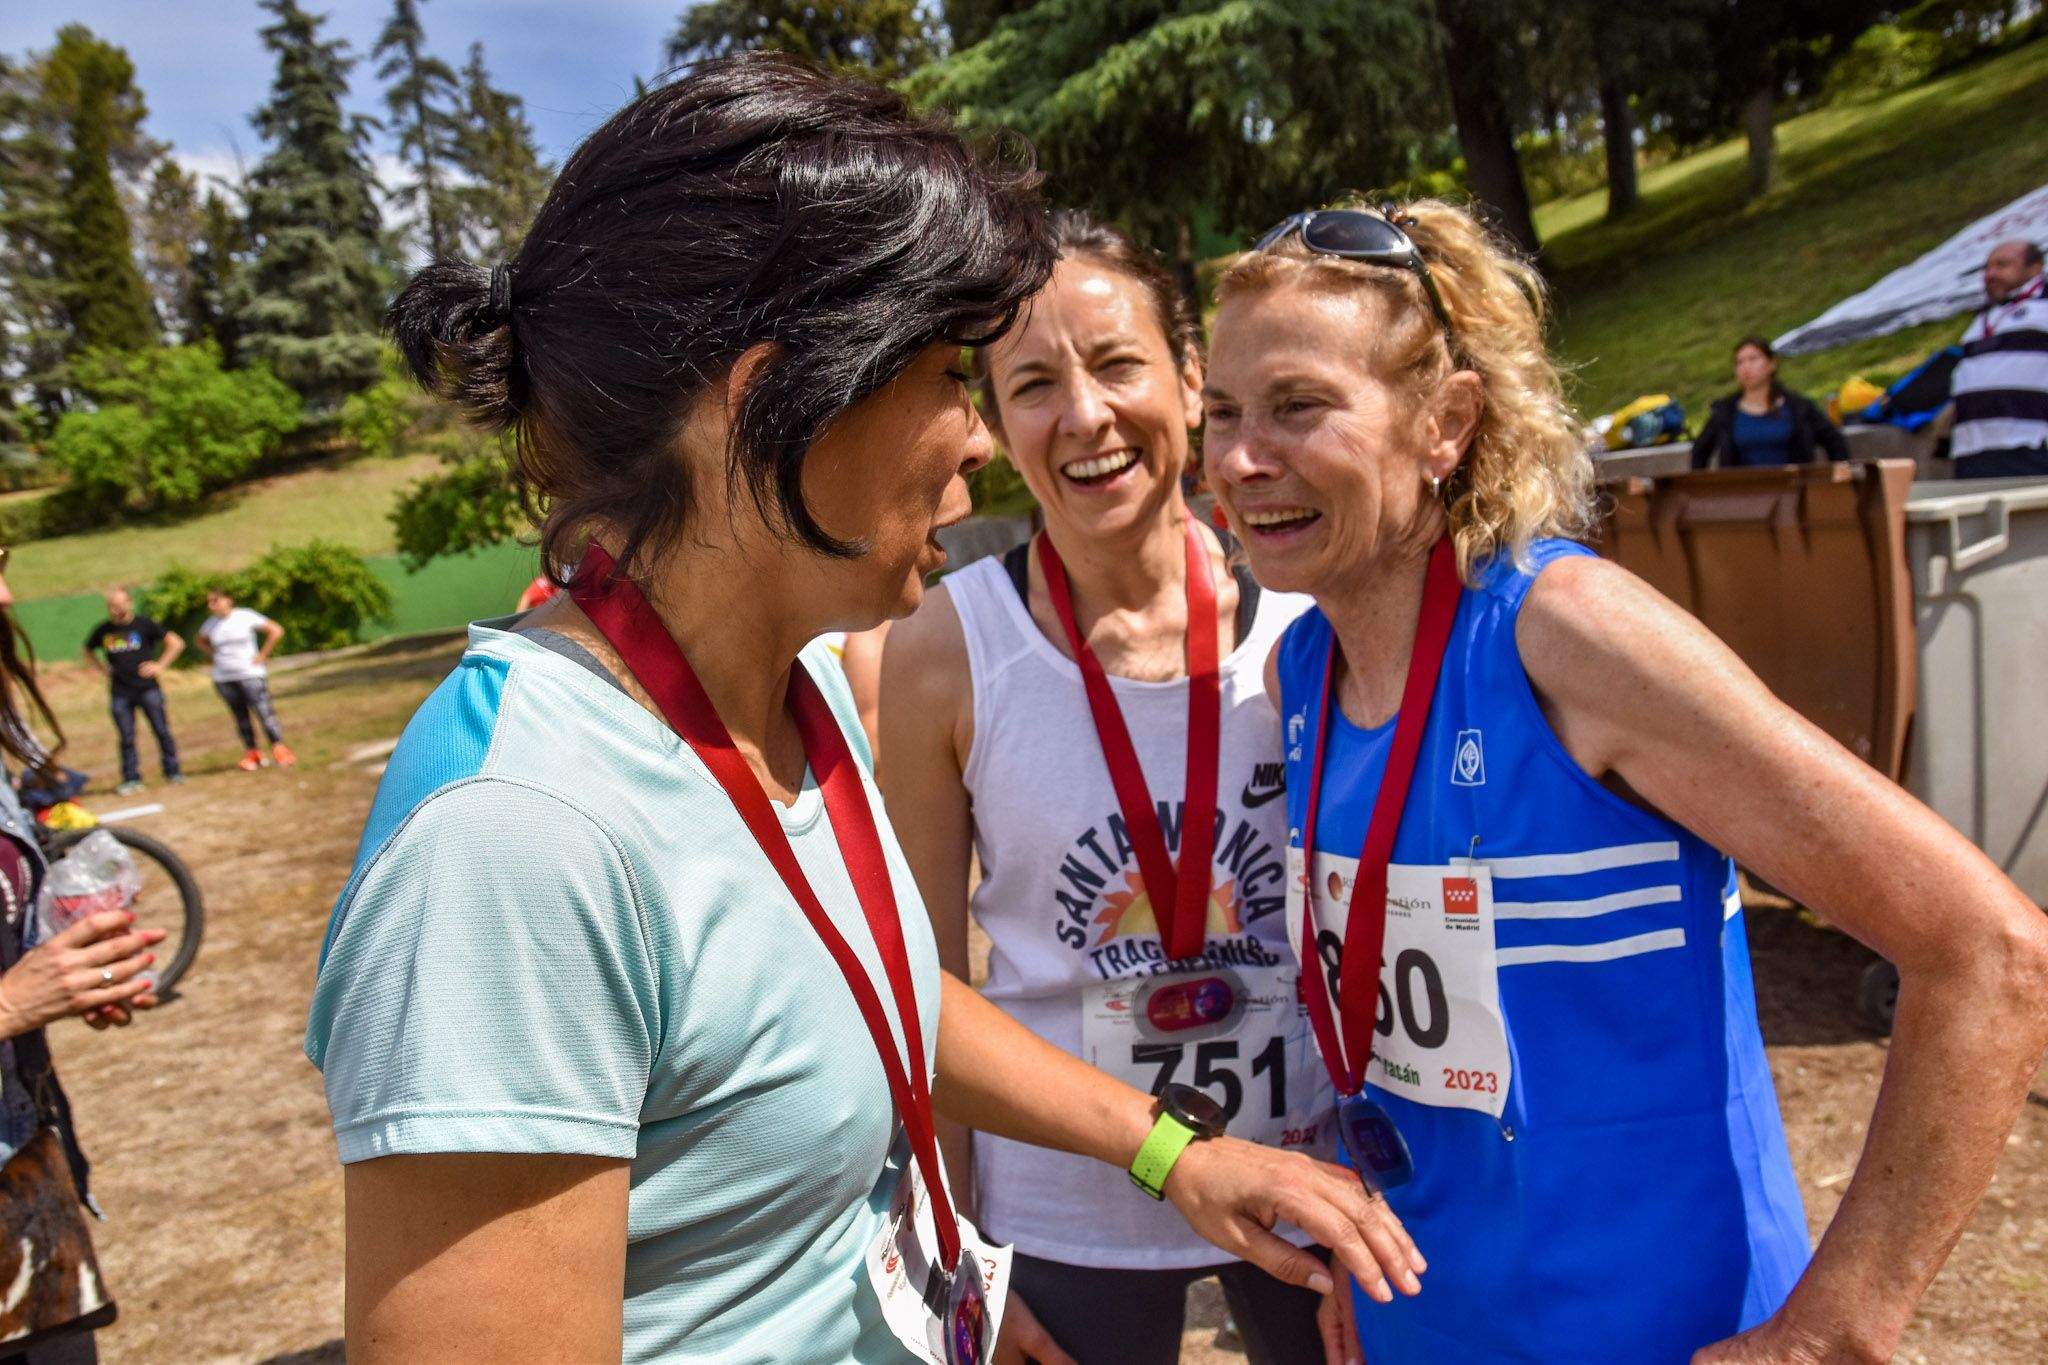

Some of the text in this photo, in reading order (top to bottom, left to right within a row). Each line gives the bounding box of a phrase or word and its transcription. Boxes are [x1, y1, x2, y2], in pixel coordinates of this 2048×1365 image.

[1251, 763, 1286, 788] NIK
[1055, 812, 1137, 950] SANTA
[1131, 1036, 1287, 1121] 751
[1442, 1067, 1498, 1095] 2023
